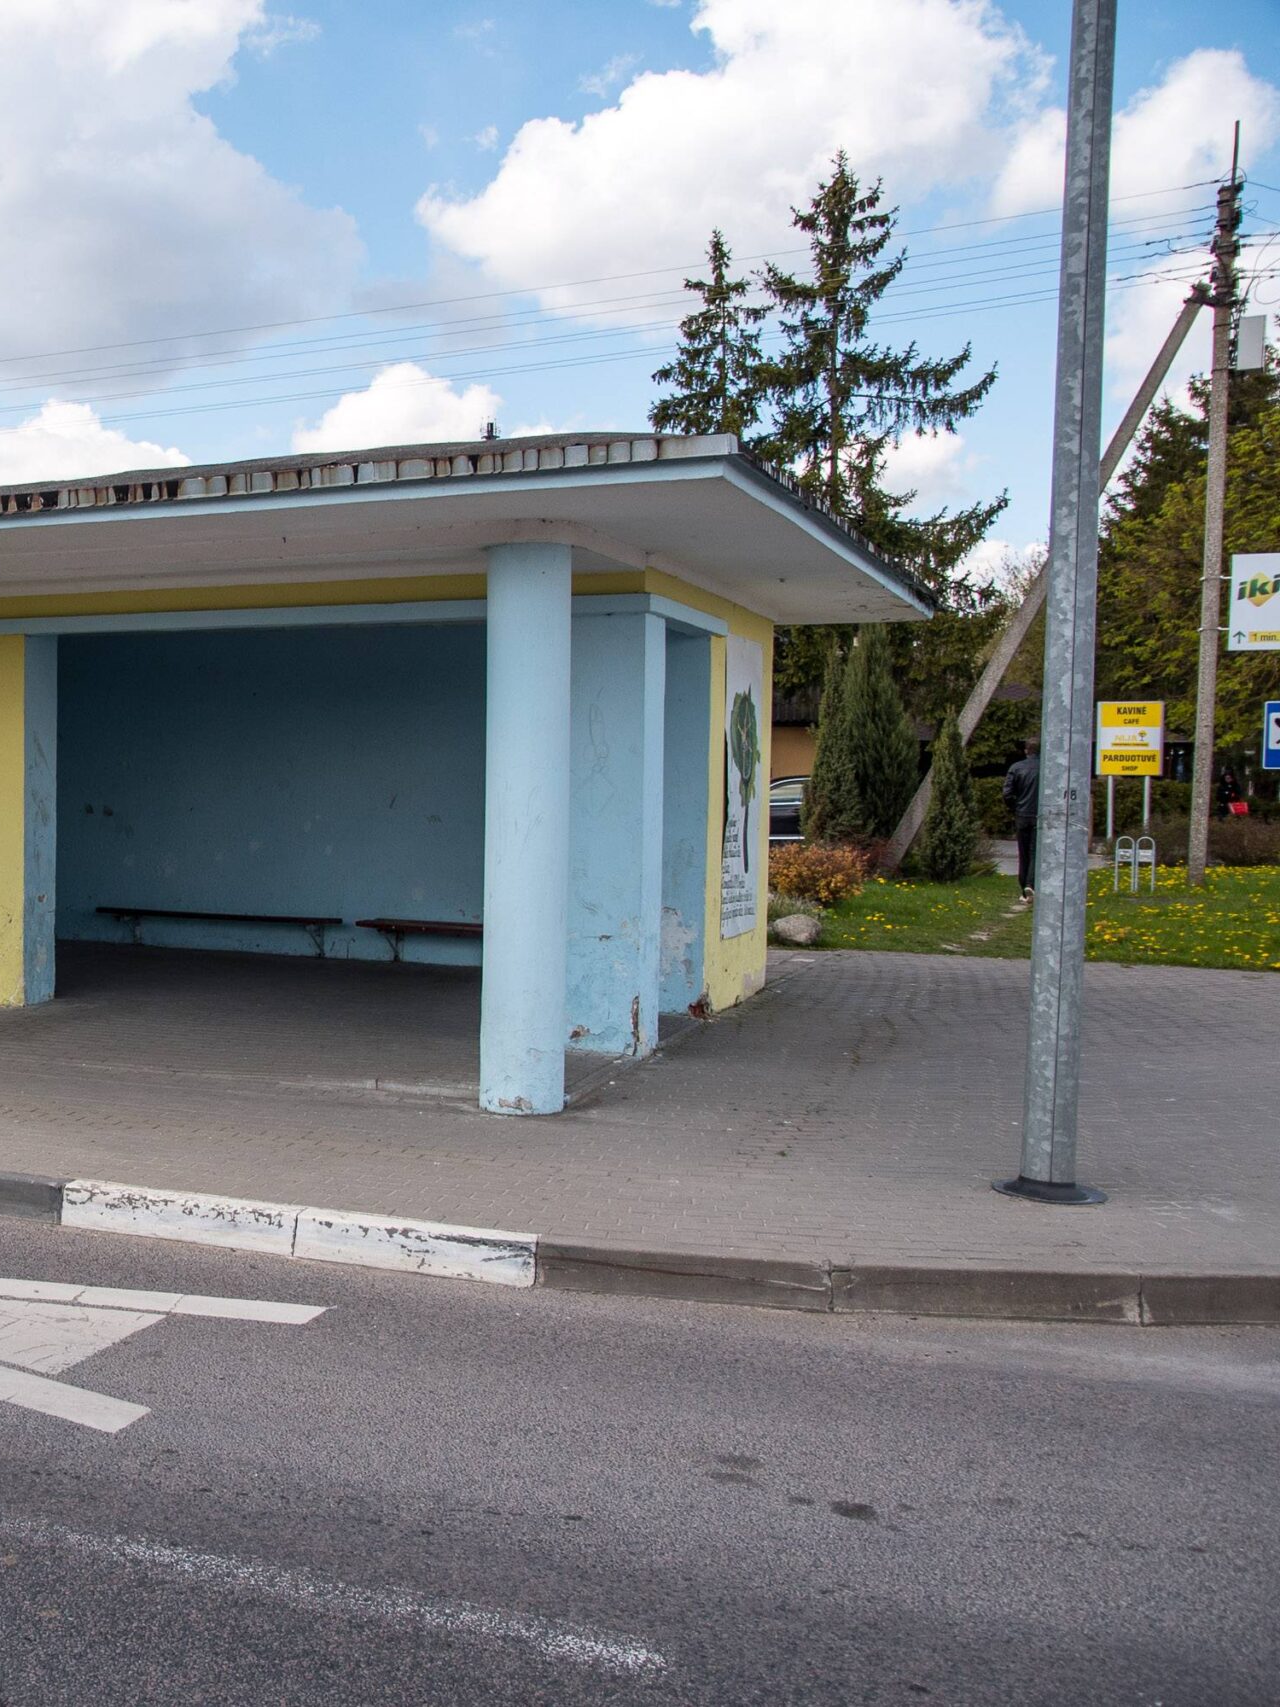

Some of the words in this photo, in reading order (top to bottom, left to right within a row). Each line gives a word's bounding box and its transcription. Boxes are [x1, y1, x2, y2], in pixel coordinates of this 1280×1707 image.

[1238, 574, 1280, 600] iki
[1251, 633, 1257, 641] 1
[1260, 633, 1280, 641] min.
